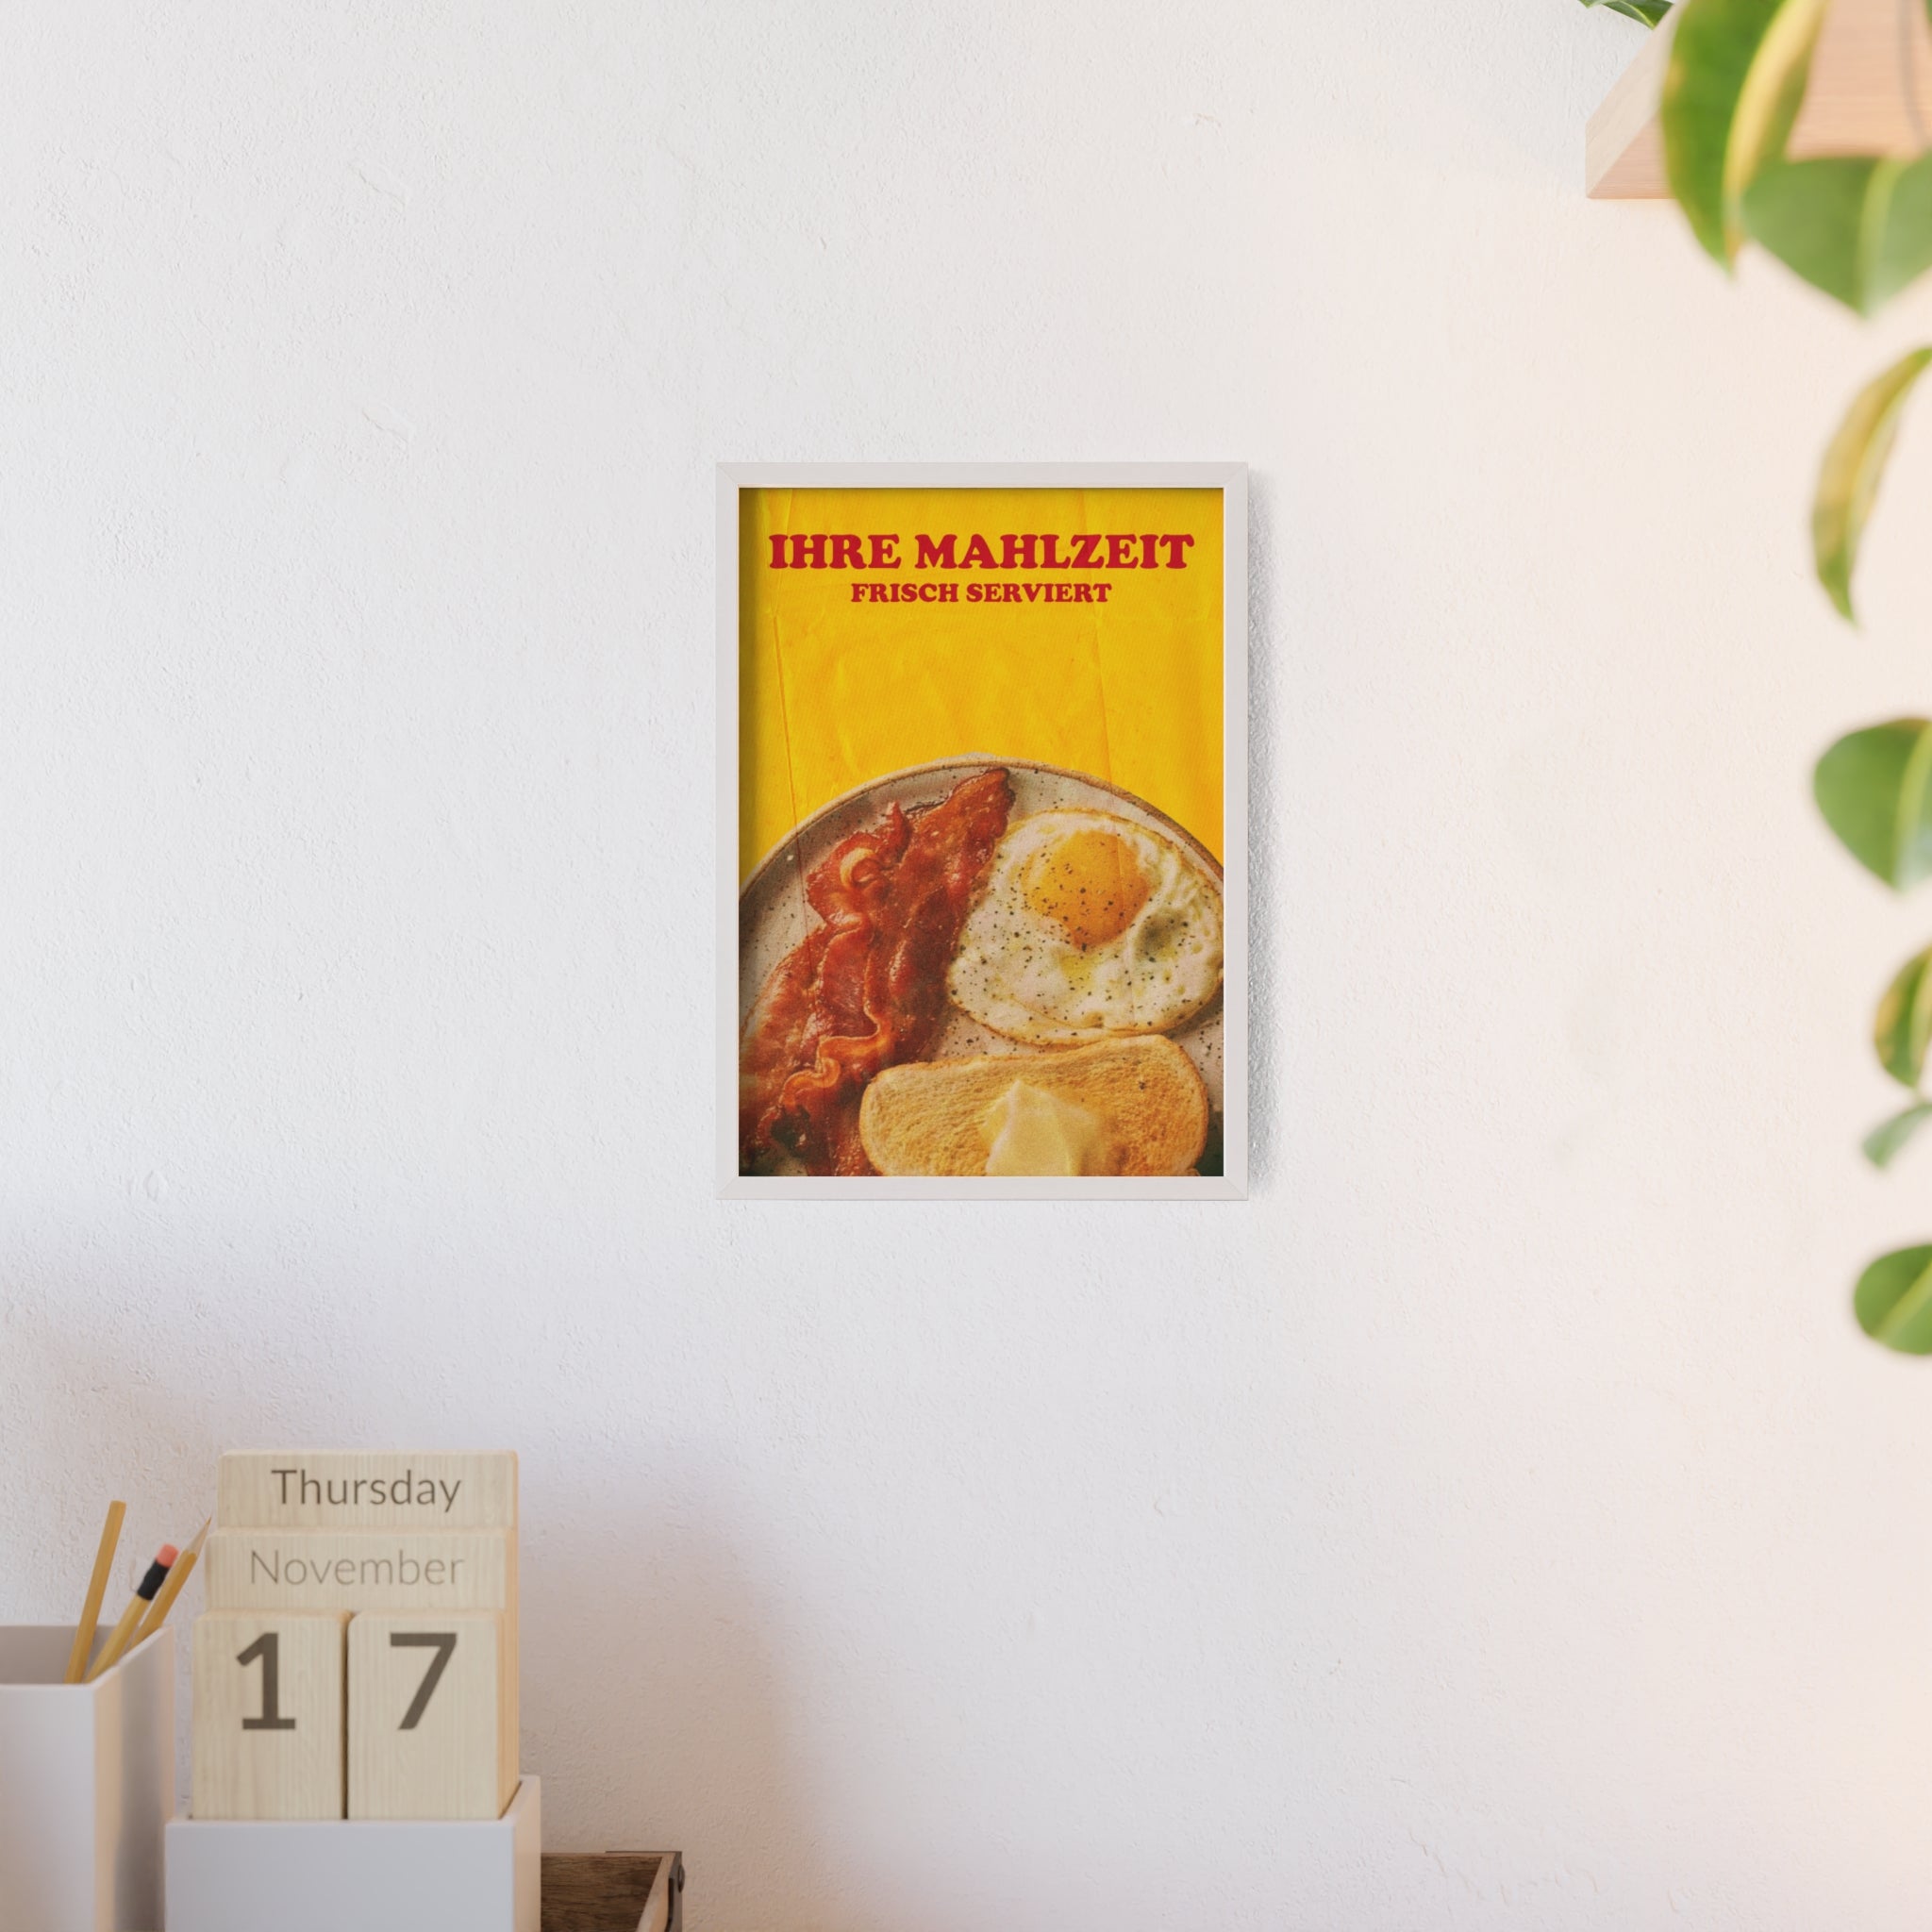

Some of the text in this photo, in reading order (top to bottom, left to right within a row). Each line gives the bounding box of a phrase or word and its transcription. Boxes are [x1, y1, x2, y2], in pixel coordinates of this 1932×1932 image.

[769, 533, 1195, 570] IHRE MAHLZEIT
[850, 583, 1112, 603] FRISCH SERVIERT
[271, 1468, 461, 1513] Thursday
[250, 1548, 465, 1586] November
